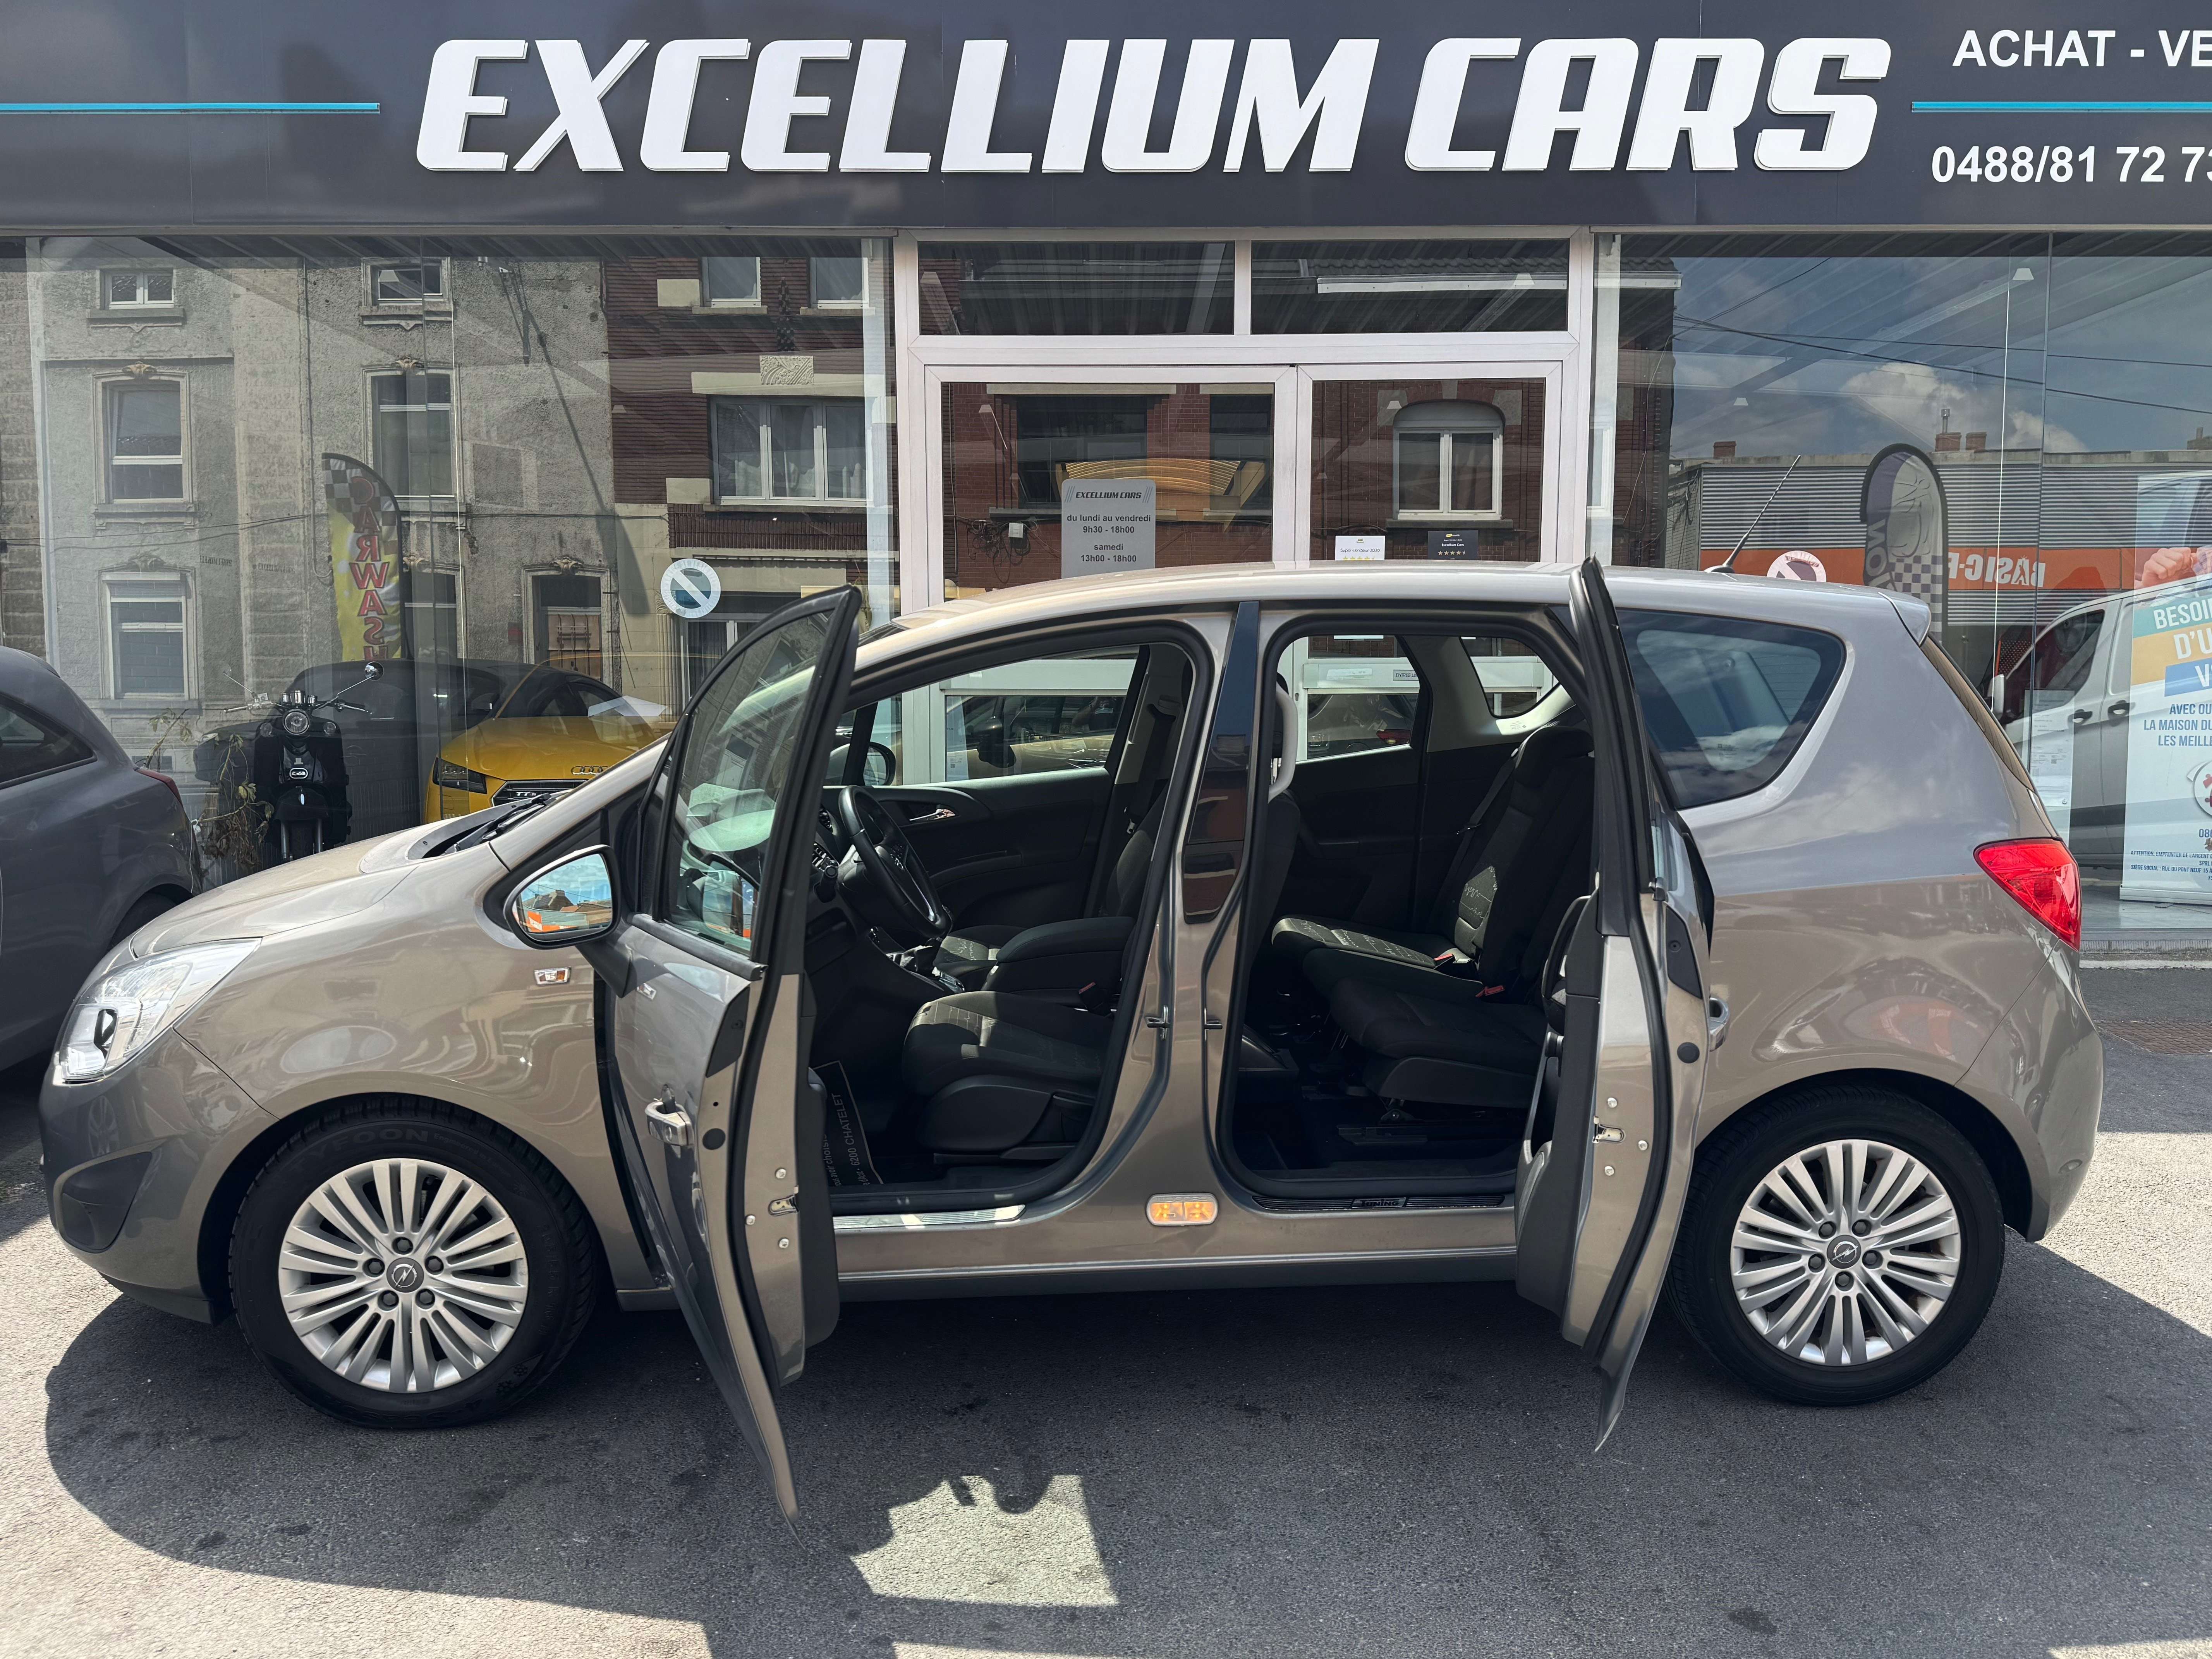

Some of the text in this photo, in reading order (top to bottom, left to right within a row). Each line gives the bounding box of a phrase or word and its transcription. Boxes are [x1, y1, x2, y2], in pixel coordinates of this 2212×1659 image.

[1952, 30, 2116, 67] ACHAT
[416, 38, 1892, 173] EXCELLIUM CARS
[1932, 145, 2212, 183] 0488/81 72 7
[2169, 704, 2196, 714] AVEC
[2144, 720, 2156, 730] LA
[2159, 720, 2198, 730] MAISON
[2158, 735, 2176, 746] LES
[831, 1093, 855, 1145] CHATELET
[848, 1147, 860, 1166] 6200
